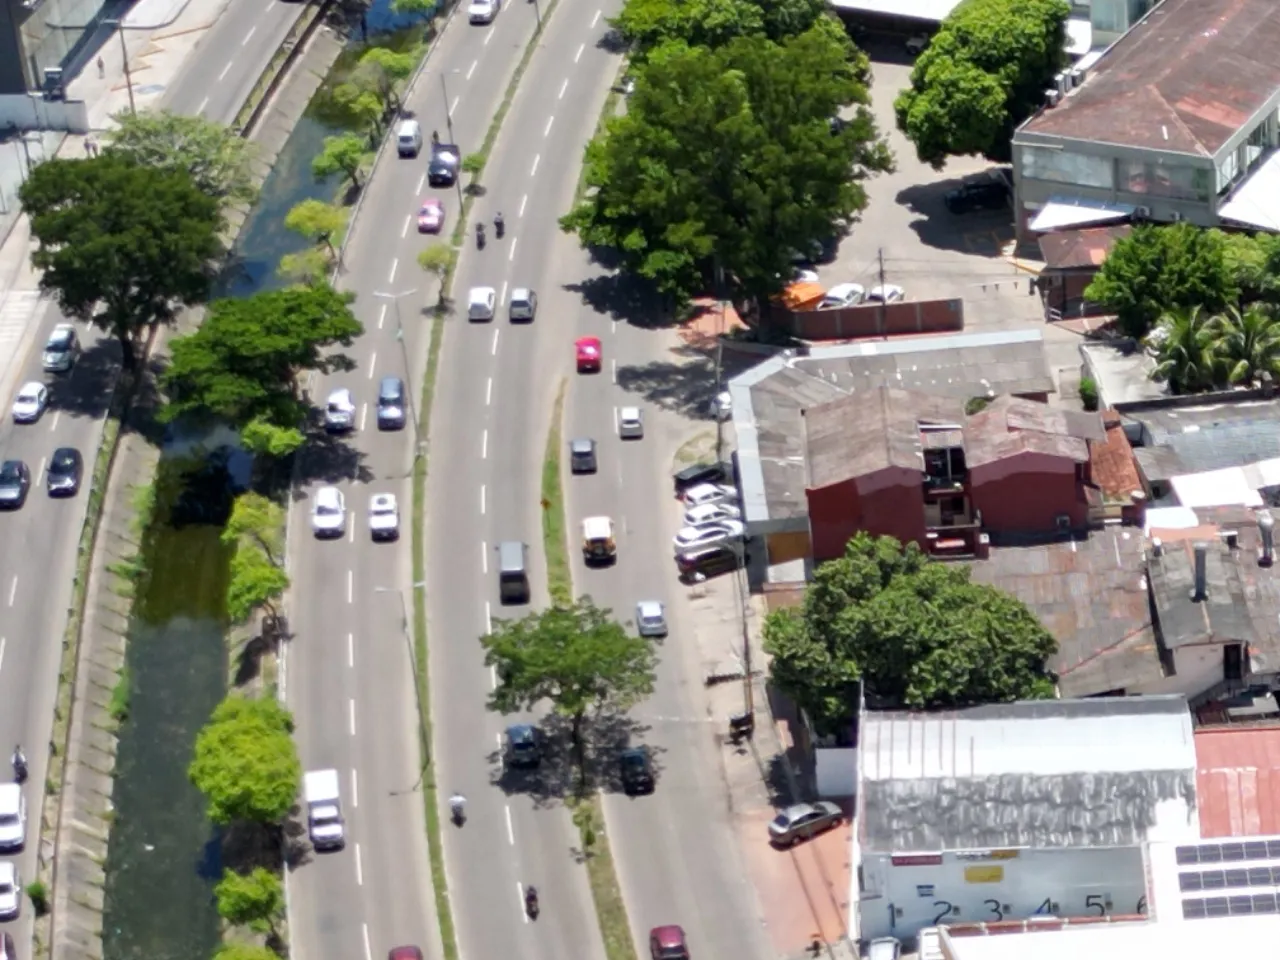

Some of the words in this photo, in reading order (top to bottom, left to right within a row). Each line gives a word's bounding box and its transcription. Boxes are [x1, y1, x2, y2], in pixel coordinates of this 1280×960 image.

[887, 902, 896, 929] 1
[933, 901, 952, 925] 2
[984, 899, 1003, 921] 3
[1085, 894, 1105, 917] 5
